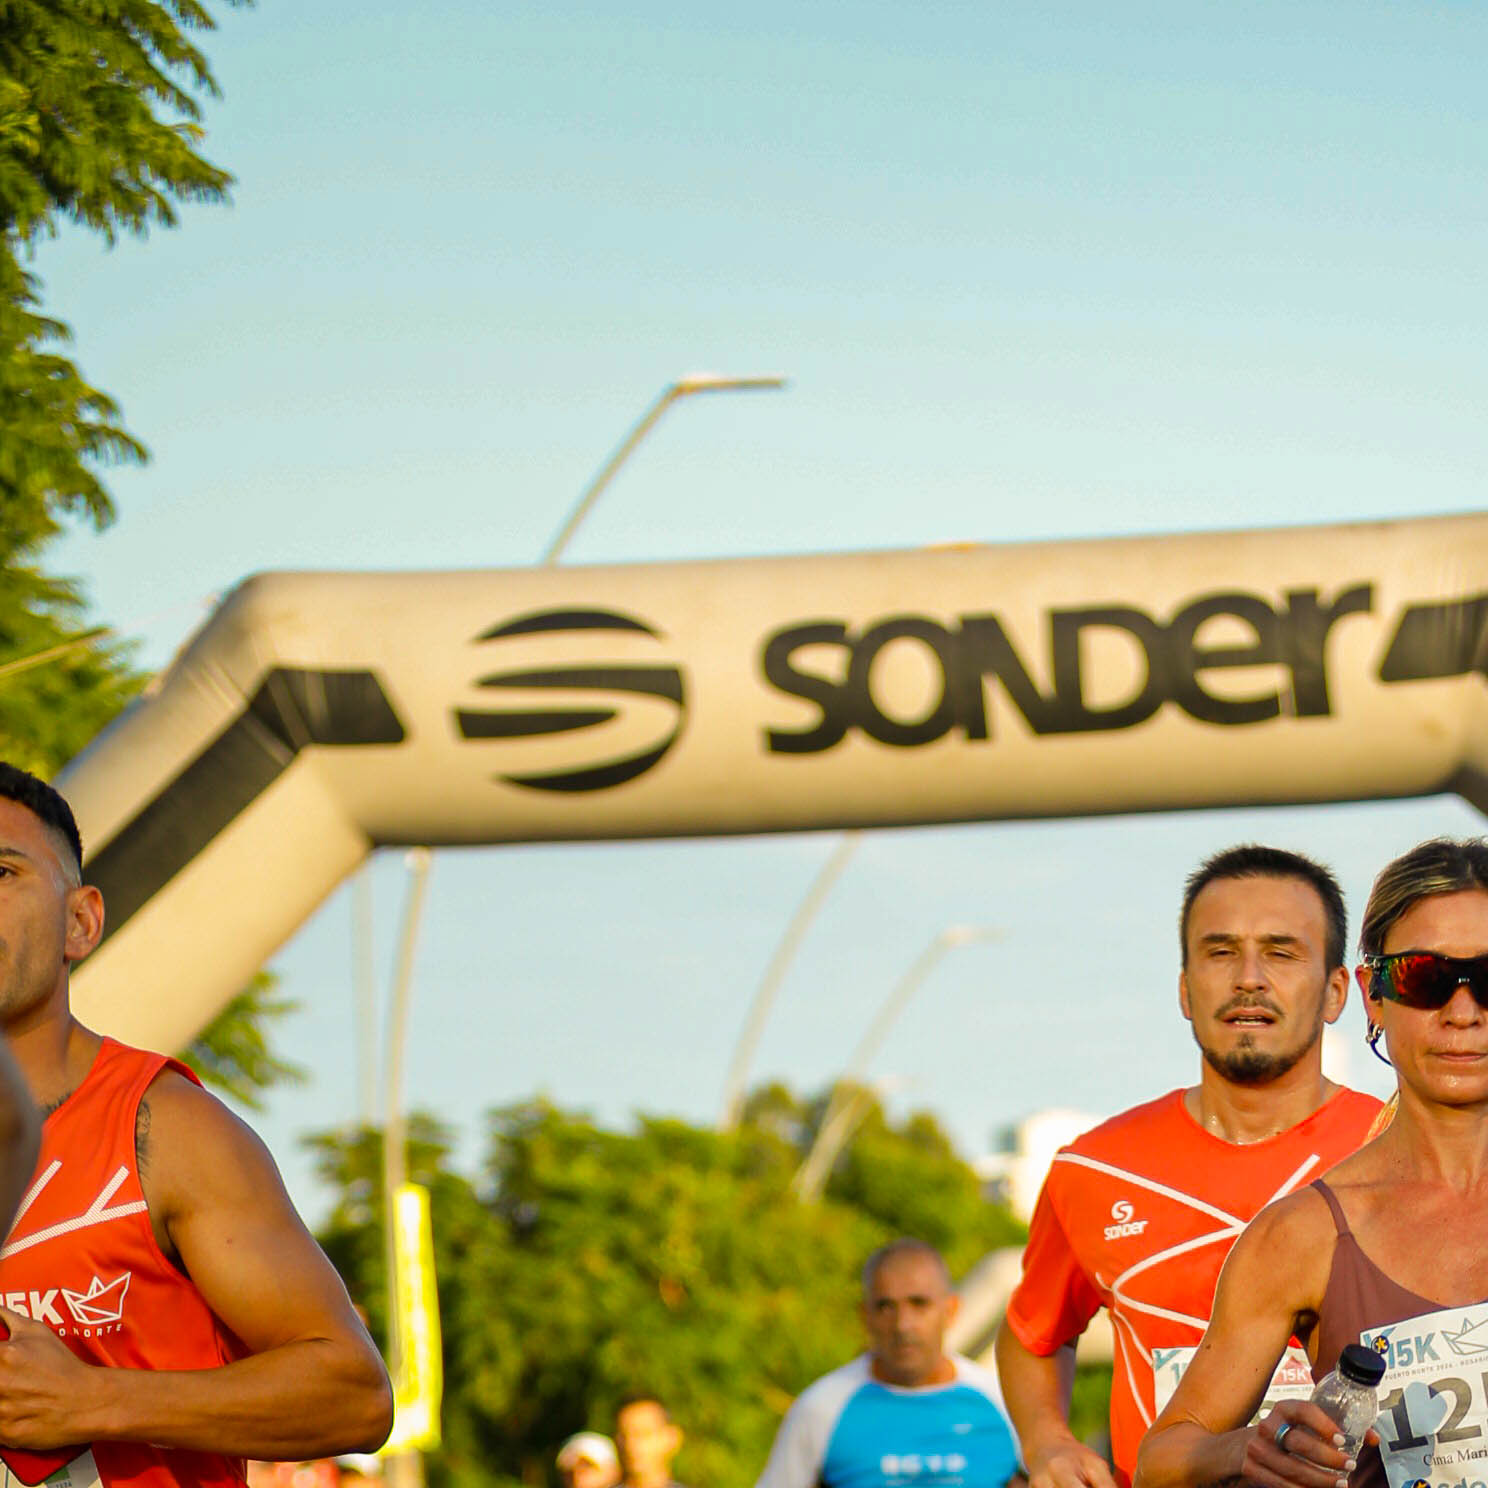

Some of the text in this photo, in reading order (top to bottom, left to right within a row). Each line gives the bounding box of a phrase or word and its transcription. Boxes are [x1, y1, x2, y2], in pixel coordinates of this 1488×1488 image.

[73, 1323, 121, 1337] NORTE
[1388, 1332, 1441, 1369] 15K
[1281, 1368, 1308, 1382] 15K
[1423, 1453, 1454, 1468] Cima
